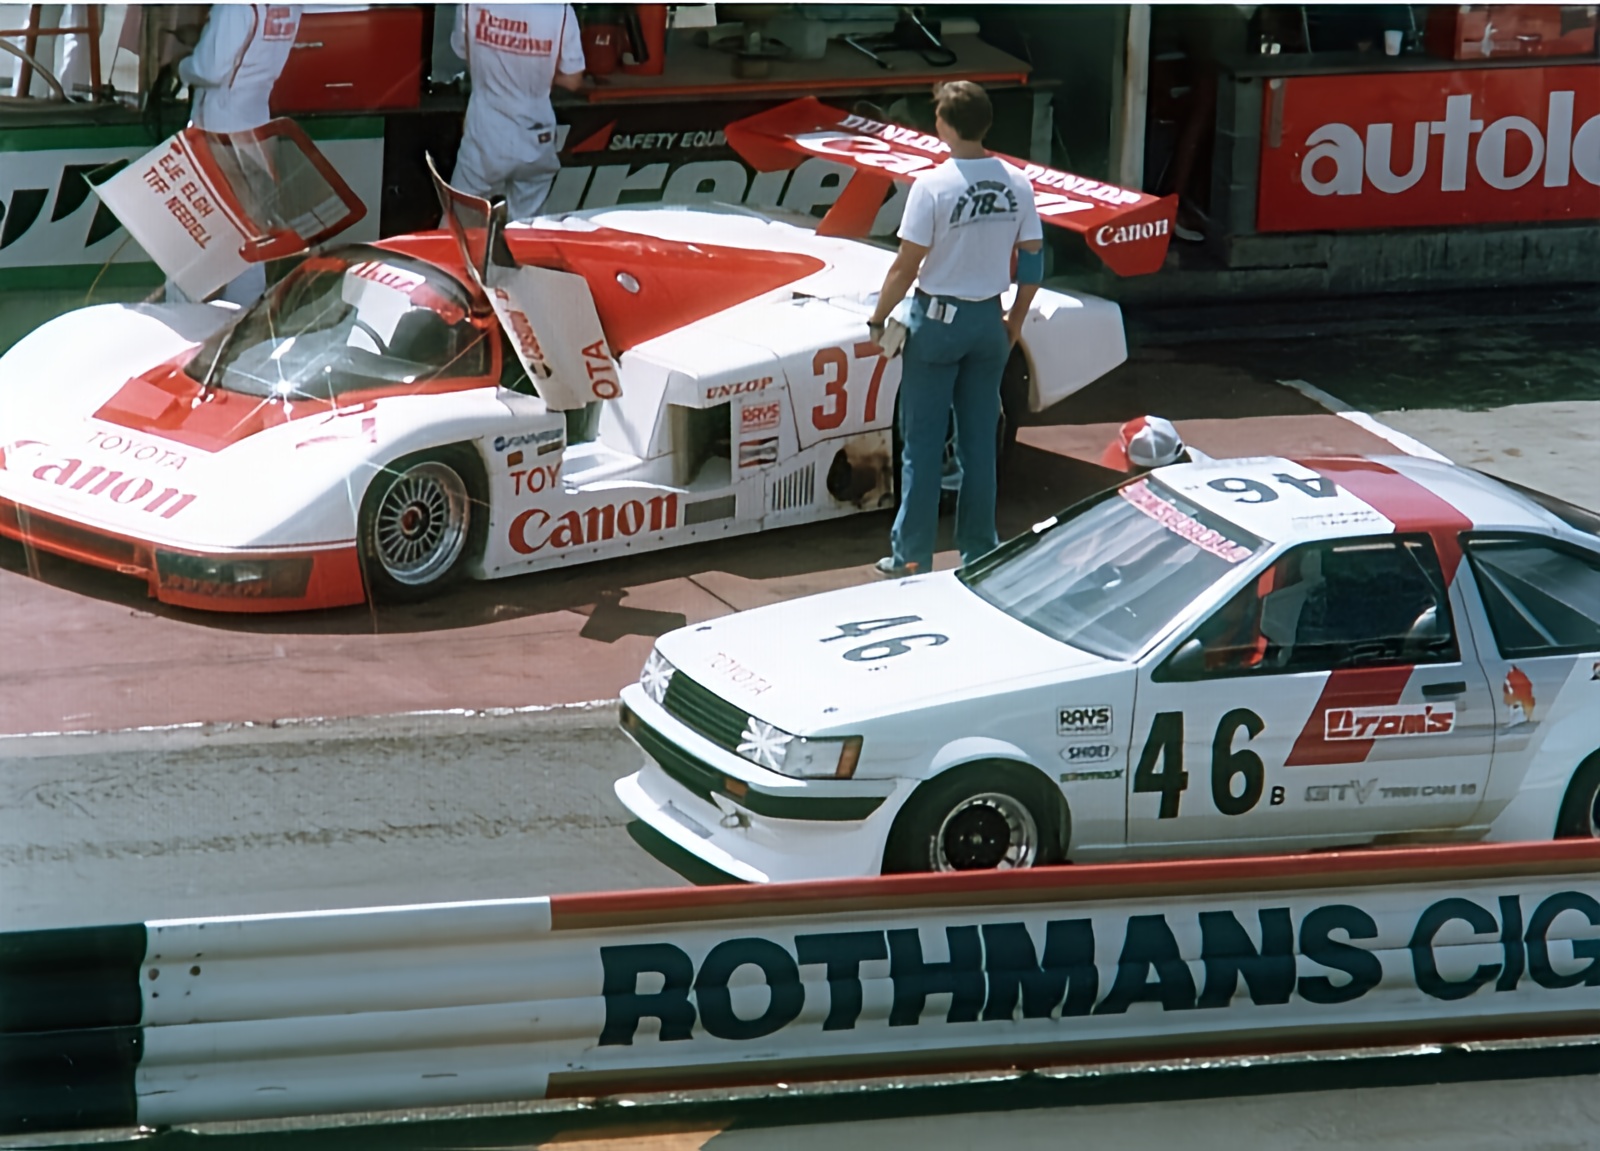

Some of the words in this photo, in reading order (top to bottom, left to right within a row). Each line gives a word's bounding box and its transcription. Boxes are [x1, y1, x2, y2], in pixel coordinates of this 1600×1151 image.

[478, 8, 528, 34] Team
[609, 132, 678, 151] SAFETY
[1023, 163, 1142, 205] DUNLOP
[1095, 218, 1169, 247] Canon
[706, 376, 774, 400] UNLOP
[811, 340, 889, 431] 37
[86, 430, 188, 470] TOYOTA
[509, 460, 564, 497] TOY
[1206, 472, 1339, 504] 46
[508, 491, 678, 555] Canon
[818, 614, 950, 662] 46
[1060, 708, 1110, 726] RAYS
[1132, 707, 1266, 820] 46
[1269, 785, 1286, 806] B
[598, 904, 1383, 1046] ROTHMANS
[1409, 891, 1600, 1001] CIG
